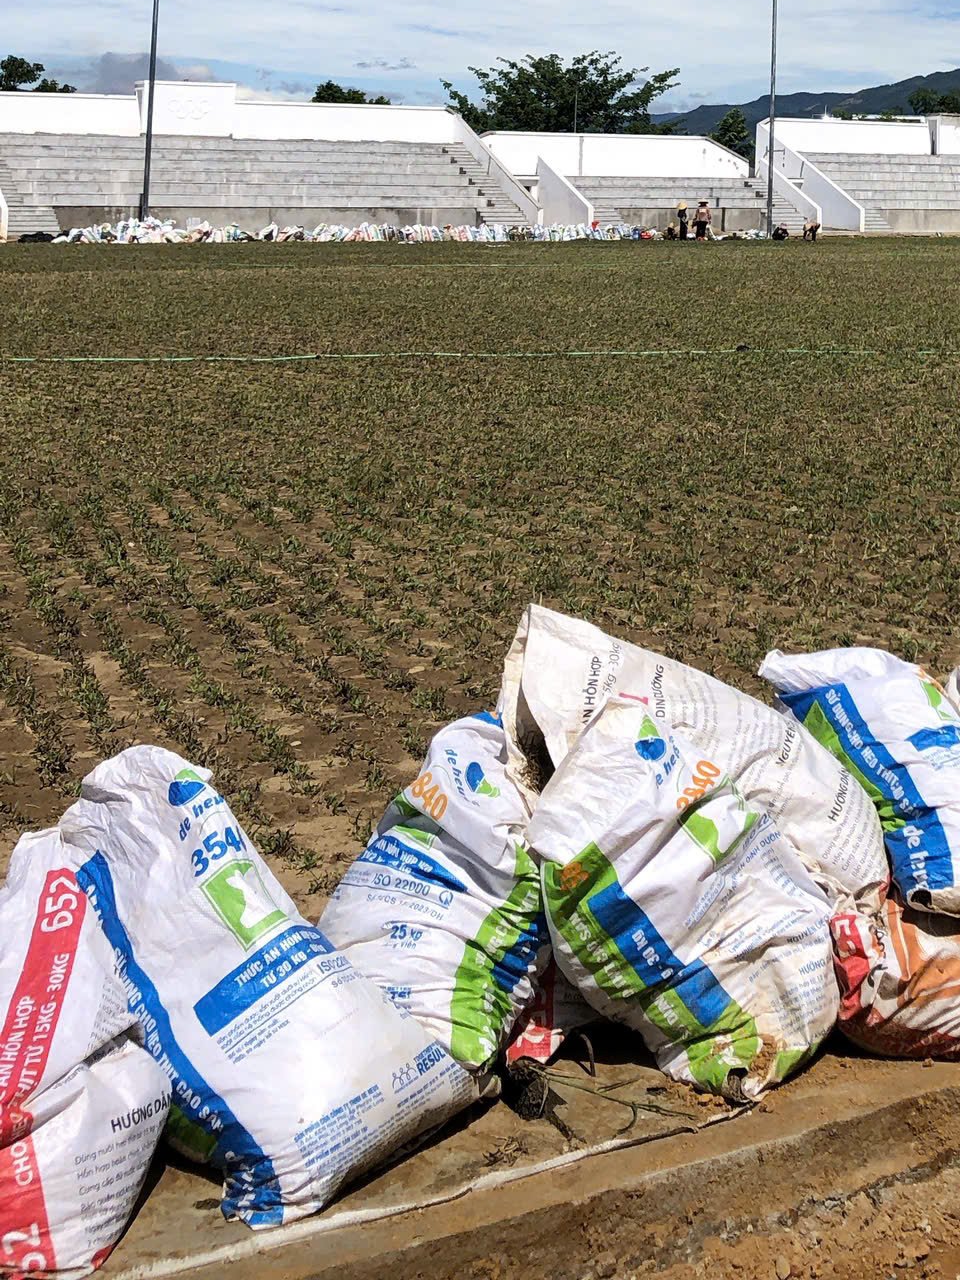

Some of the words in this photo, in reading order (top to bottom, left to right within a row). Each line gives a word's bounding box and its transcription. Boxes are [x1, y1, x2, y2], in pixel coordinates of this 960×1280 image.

[602, 673, 617, 696] 5kg
[861, 746, 877, 769] HEO
[192, 794, 225, 818] heu
[411, 771, 449, 821] 840
[191, 825, 247, 877] 354
[395, 878, 430, 897] 22000
[41, 877, 80, 933] 652
[390, 924, 408, 940] 25
[10, 1142, 34, 1186] CHO
[32, 1003, 55, 1042] 15KG
[47, 953, 70, 992] 30KG
[176, 1081, 200, 1110] CAO
